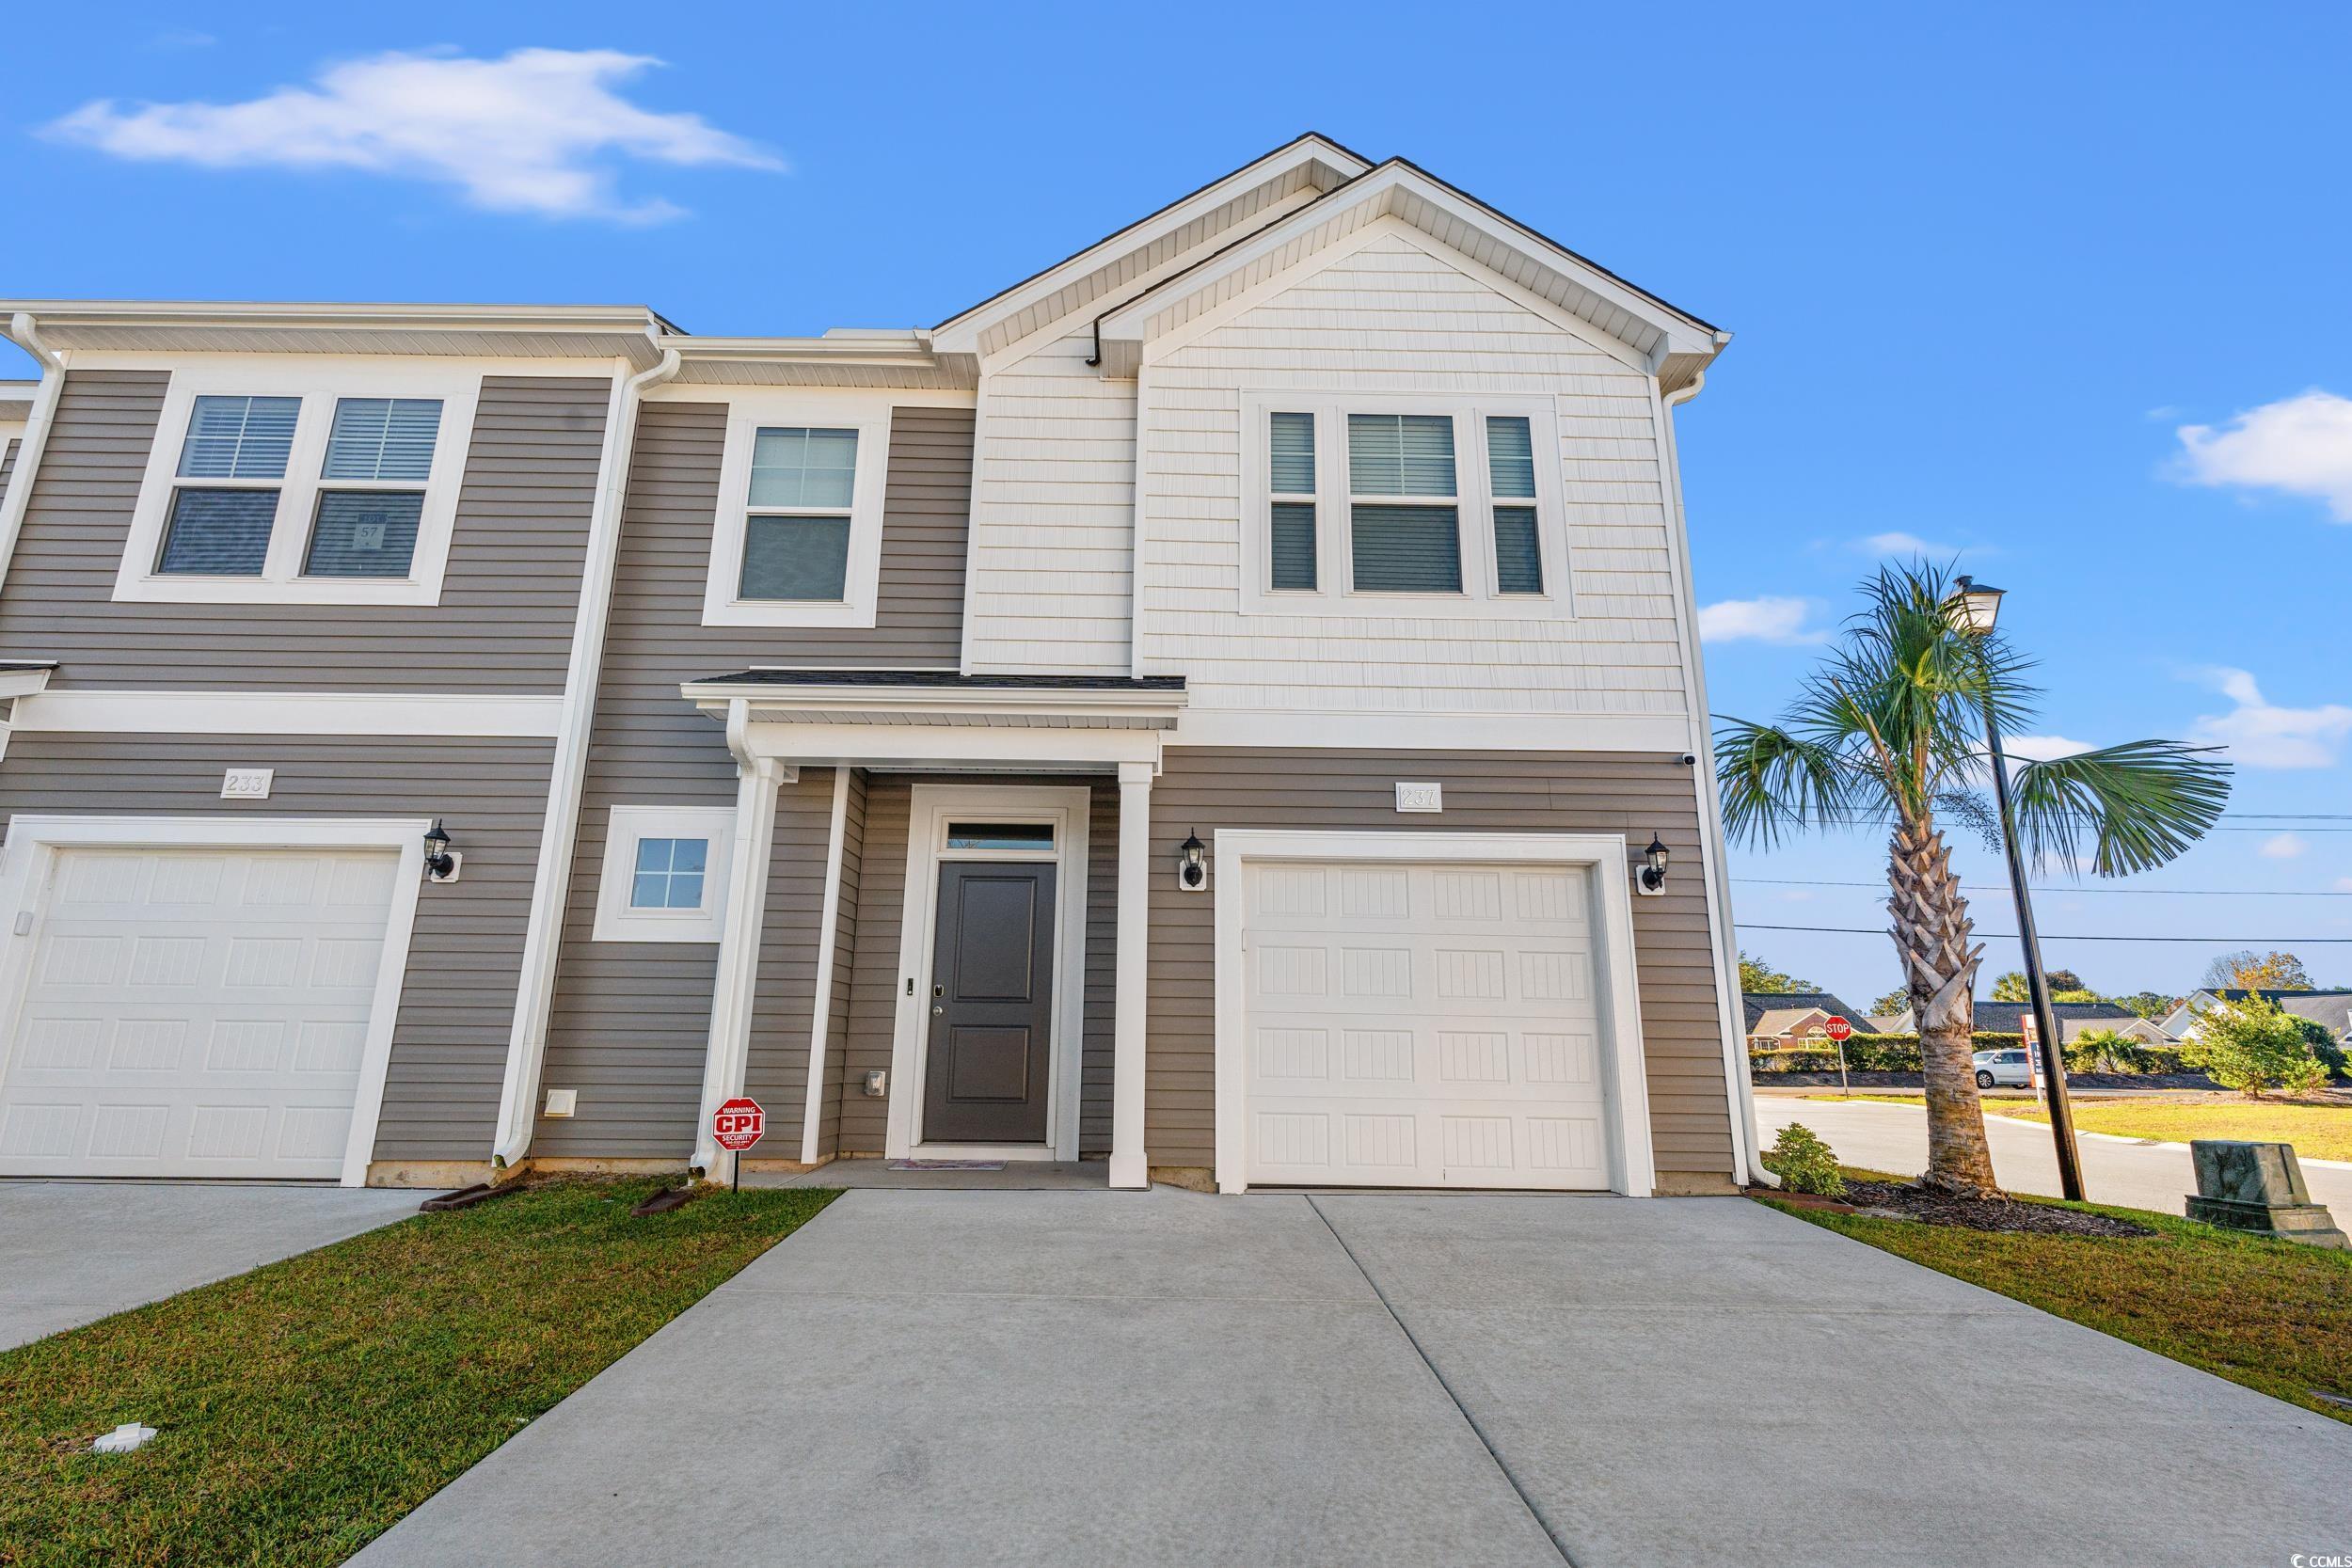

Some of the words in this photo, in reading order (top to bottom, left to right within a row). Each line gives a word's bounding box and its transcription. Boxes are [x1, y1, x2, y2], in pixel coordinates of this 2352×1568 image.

[360, 527, 378, 537] 57
[226, 775, 264, 791] 233
[1402, 789, 1436, 805] 237
[1827, 1023, 1850, 1033] STOP
[716, 1116, 761, 1132] CPI
